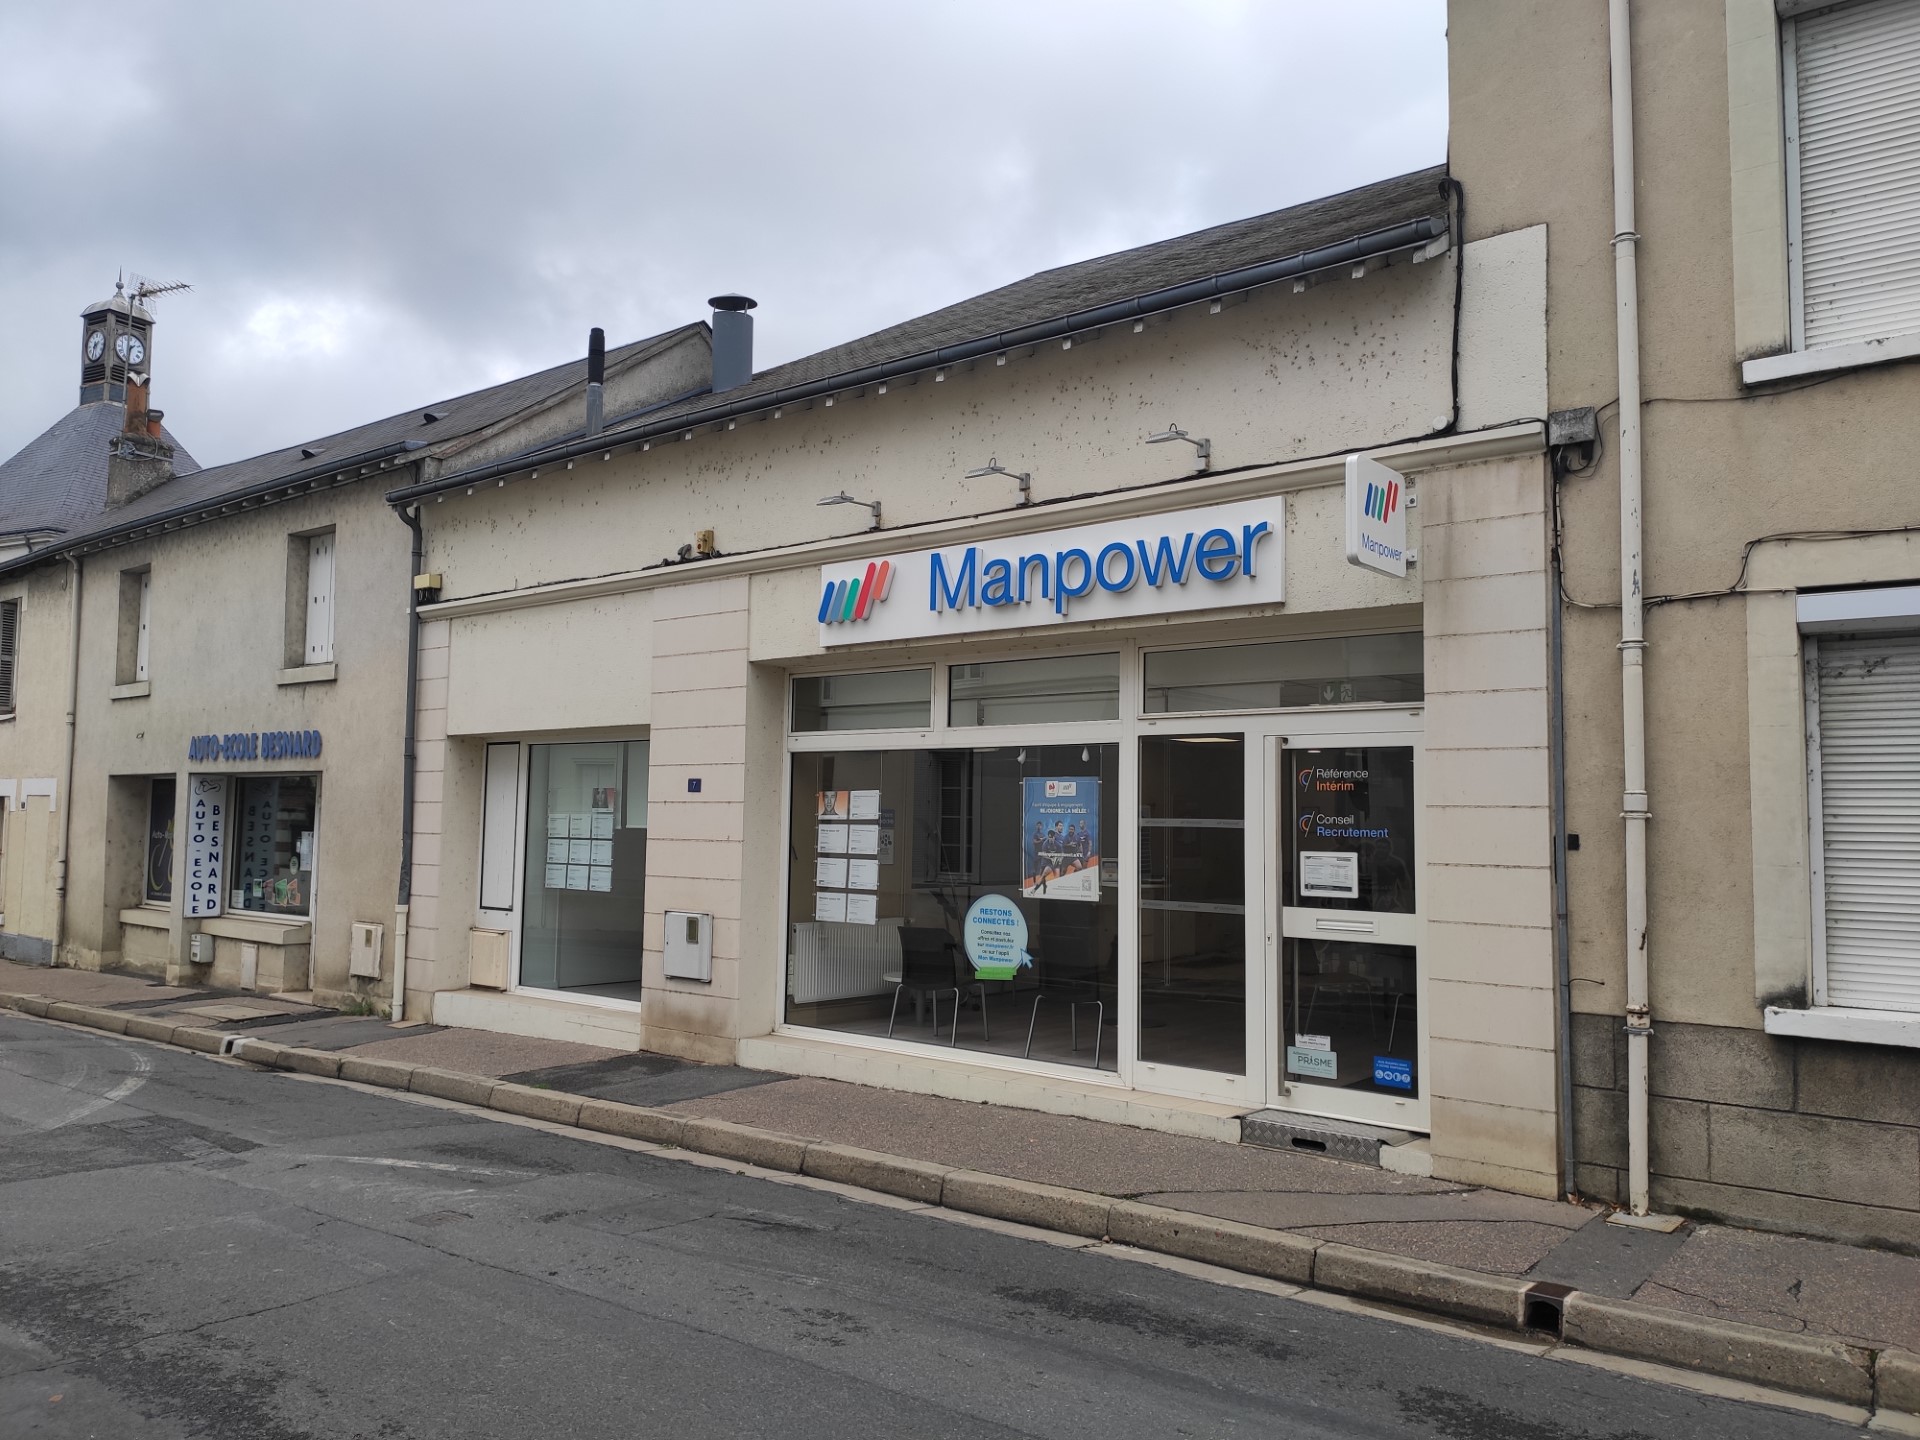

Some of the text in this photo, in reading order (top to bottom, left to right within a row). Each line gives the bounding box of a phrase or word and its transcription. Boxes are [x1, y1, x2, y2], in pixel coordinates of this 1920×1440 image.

[1361, 532, 1403, 561] Manpower
[930, 521, 1274, 615] Manpower
[188, 730, 323, 763] AUTO-ECOLE BESNARD
[1316, 768, 1369, 779] Référence
[1316, 780, 1355, 791] Intérim
[1316, 813, 1355, 824] Conseil
[1316, 826, 1389, 838] Recrutement
[980, 908, 1013, 917] RESTONS
[972, 916, 1016, 926] CONNECTÉS
